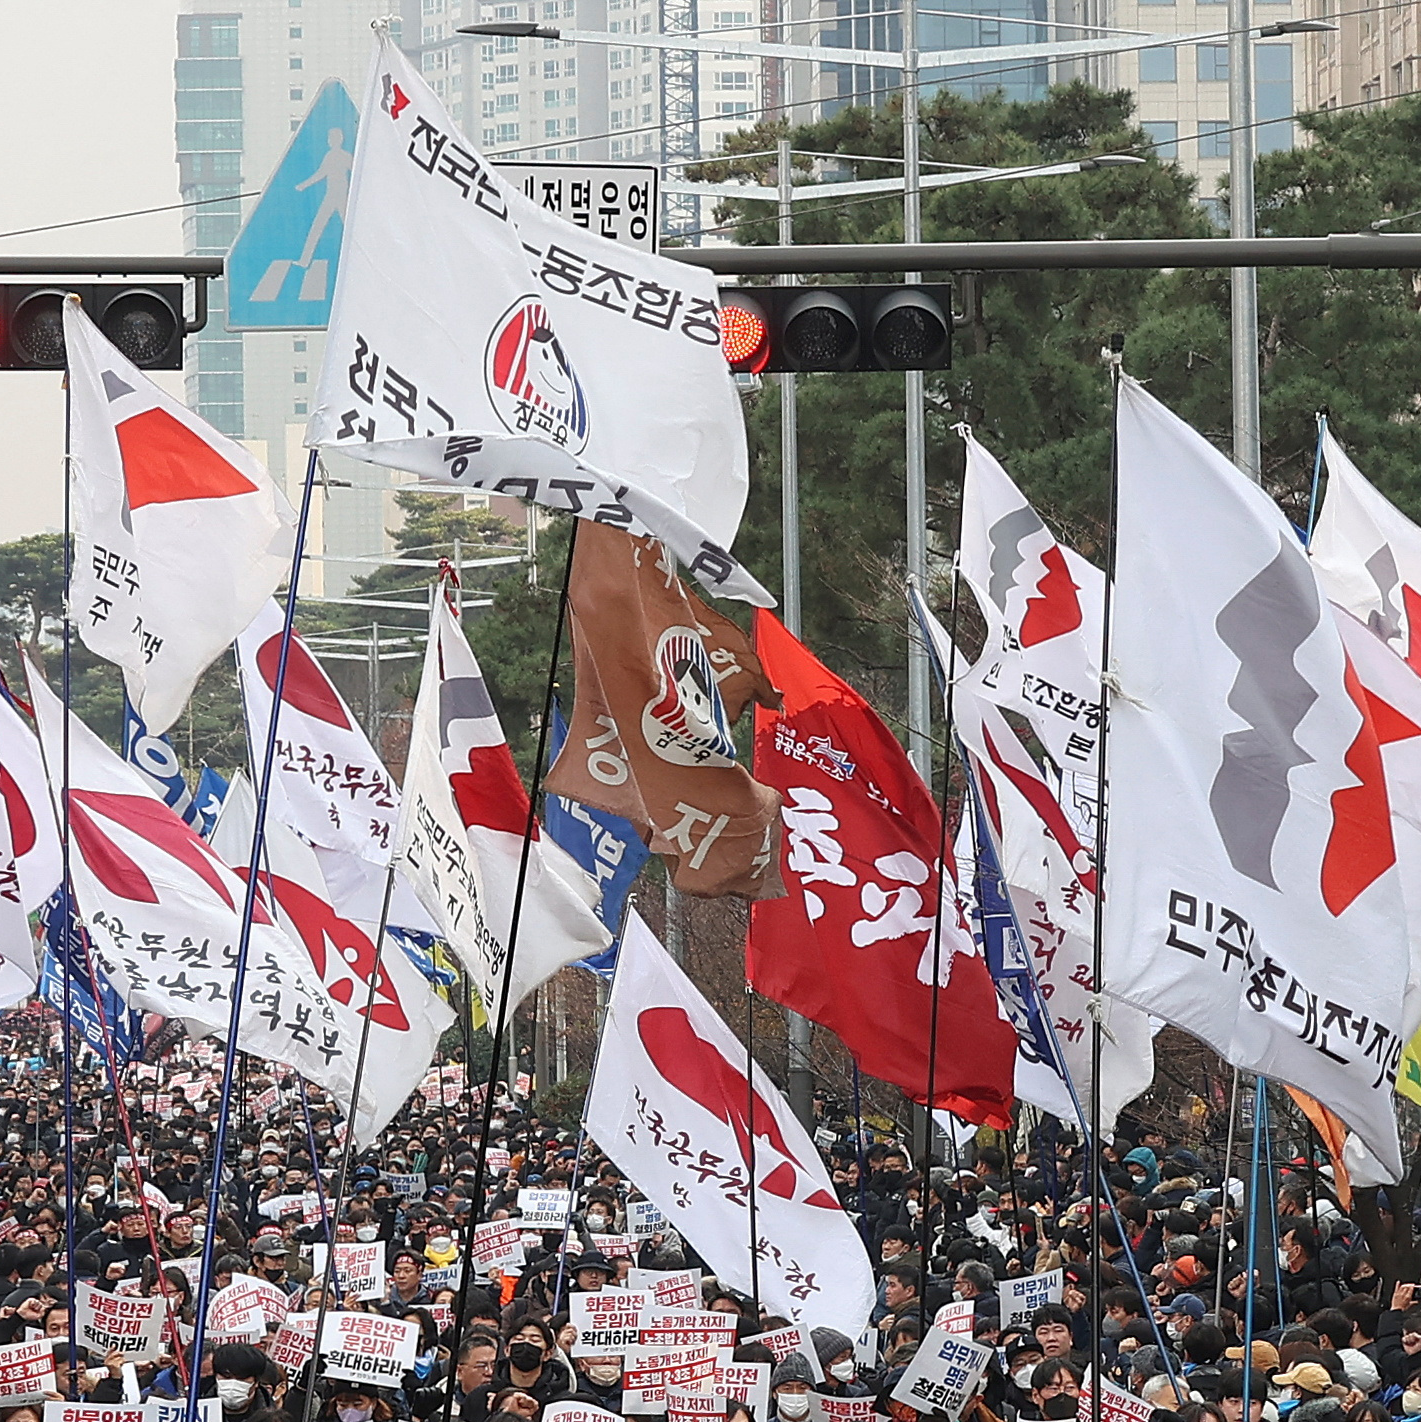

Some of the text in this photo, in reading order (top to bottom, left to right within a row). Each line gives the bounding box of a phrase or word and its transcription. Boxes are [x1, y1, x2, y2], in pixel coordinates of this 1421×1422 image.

[88, 1294, 154, 1320] 화물안전
[93, 1312, 142, 1336] 운임제
[338, 1316, 407, 1342] 화물안전
[592, 1312, 638, 1329] 운임제
[699, 1315, 726, 1329] 저지!
[83, 1325, 148, 1352] 확대하라!
[343, 1334, 394, 1357] 운임제
[328, 1351, 402, 1378] 확대하라!
